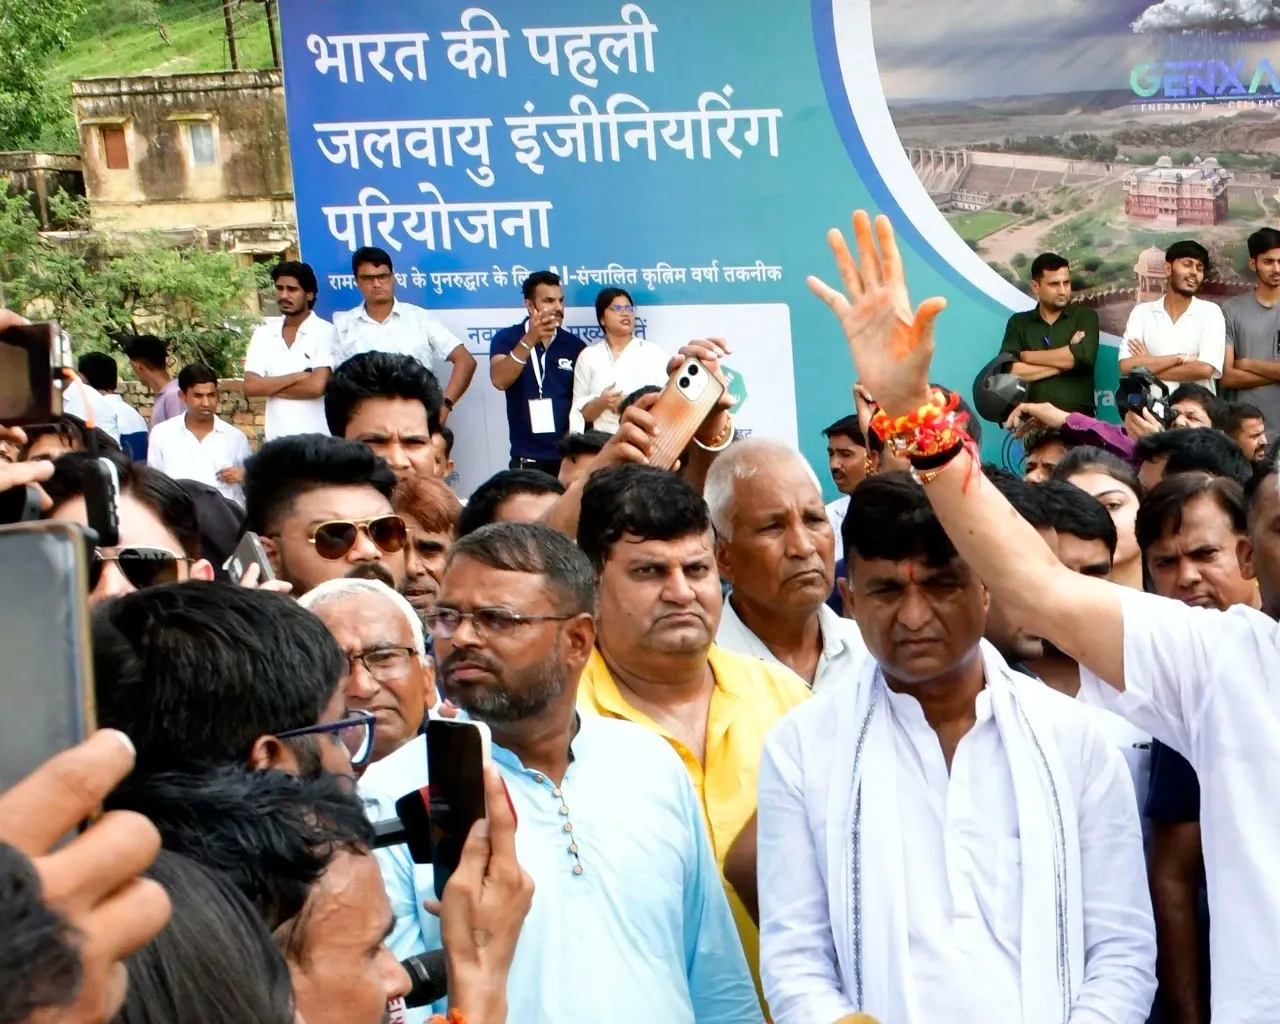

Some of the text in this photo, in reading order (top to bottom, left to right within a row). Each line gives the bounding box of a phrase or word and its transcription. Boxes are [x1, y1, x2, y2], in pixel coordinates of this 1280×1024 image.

[307, 4, 659, 87] भारत की पहली
[313, 85, 783, 187] जलवायु इंजीनियरिंग
[321, 182, 553, 252] परियोजना
[411, 266, 427, 288] के
[430, 271, 489, 294] पुनरुद्धार
[492, 265, 508, 286] के
[690, 259, 719, 283] वर्षा
[723, 260, 782, 282] तकनीक
